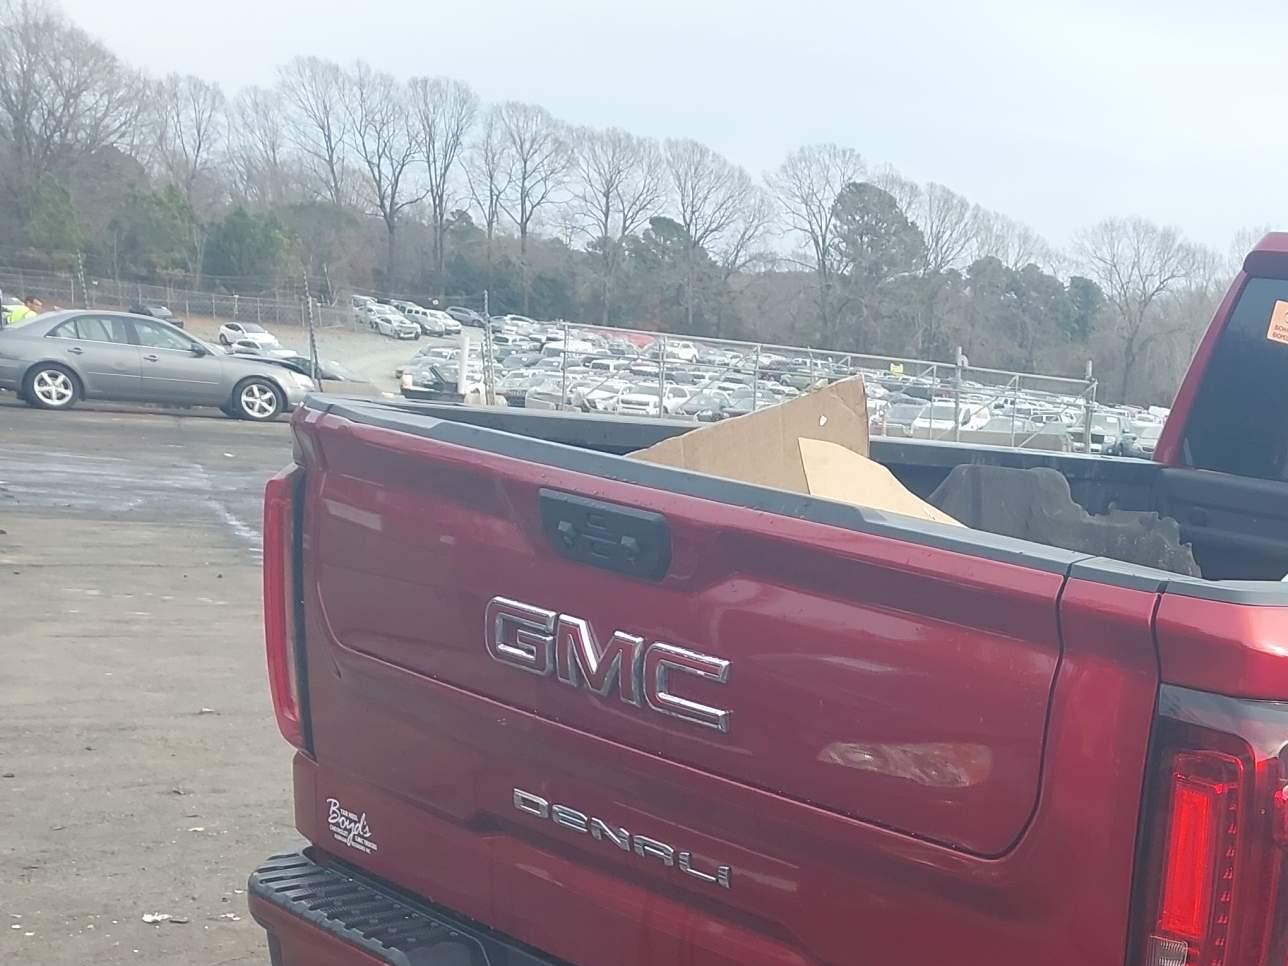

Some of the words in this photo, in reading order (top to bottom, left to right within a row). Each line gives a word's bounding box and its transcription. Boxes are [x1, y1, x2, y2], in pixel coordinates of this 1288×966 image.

[485, 596, 734, 733] GMC
[326, 798, 372, 847] Boyd's
[512, 787, 732, 888] DENALI
